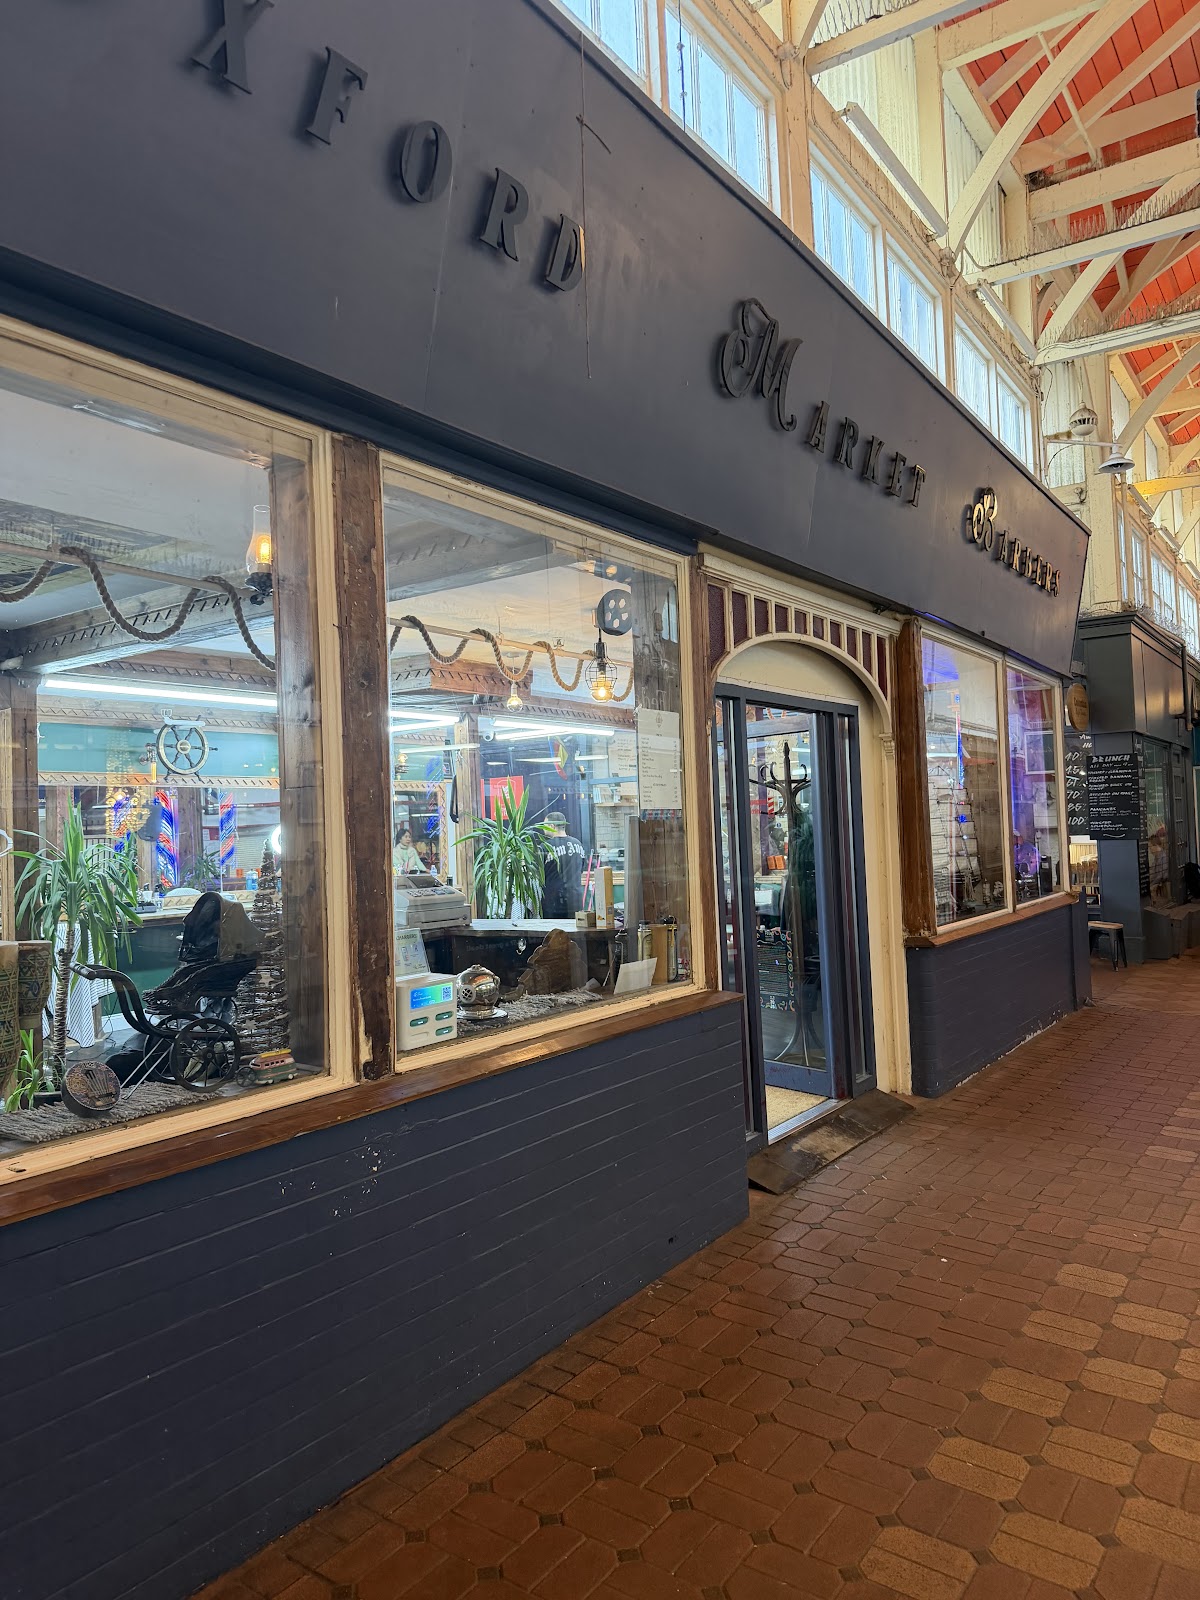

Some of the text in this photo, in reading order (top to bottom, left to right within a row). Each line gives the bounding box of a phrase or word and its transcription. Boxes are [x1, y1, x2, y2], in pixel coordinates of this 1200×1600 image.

[720, 297, 927, 508] MARKET
[972, 487, 1061, 598] BARBERS
[1091, 754, 1131, 764] BRUNCH
